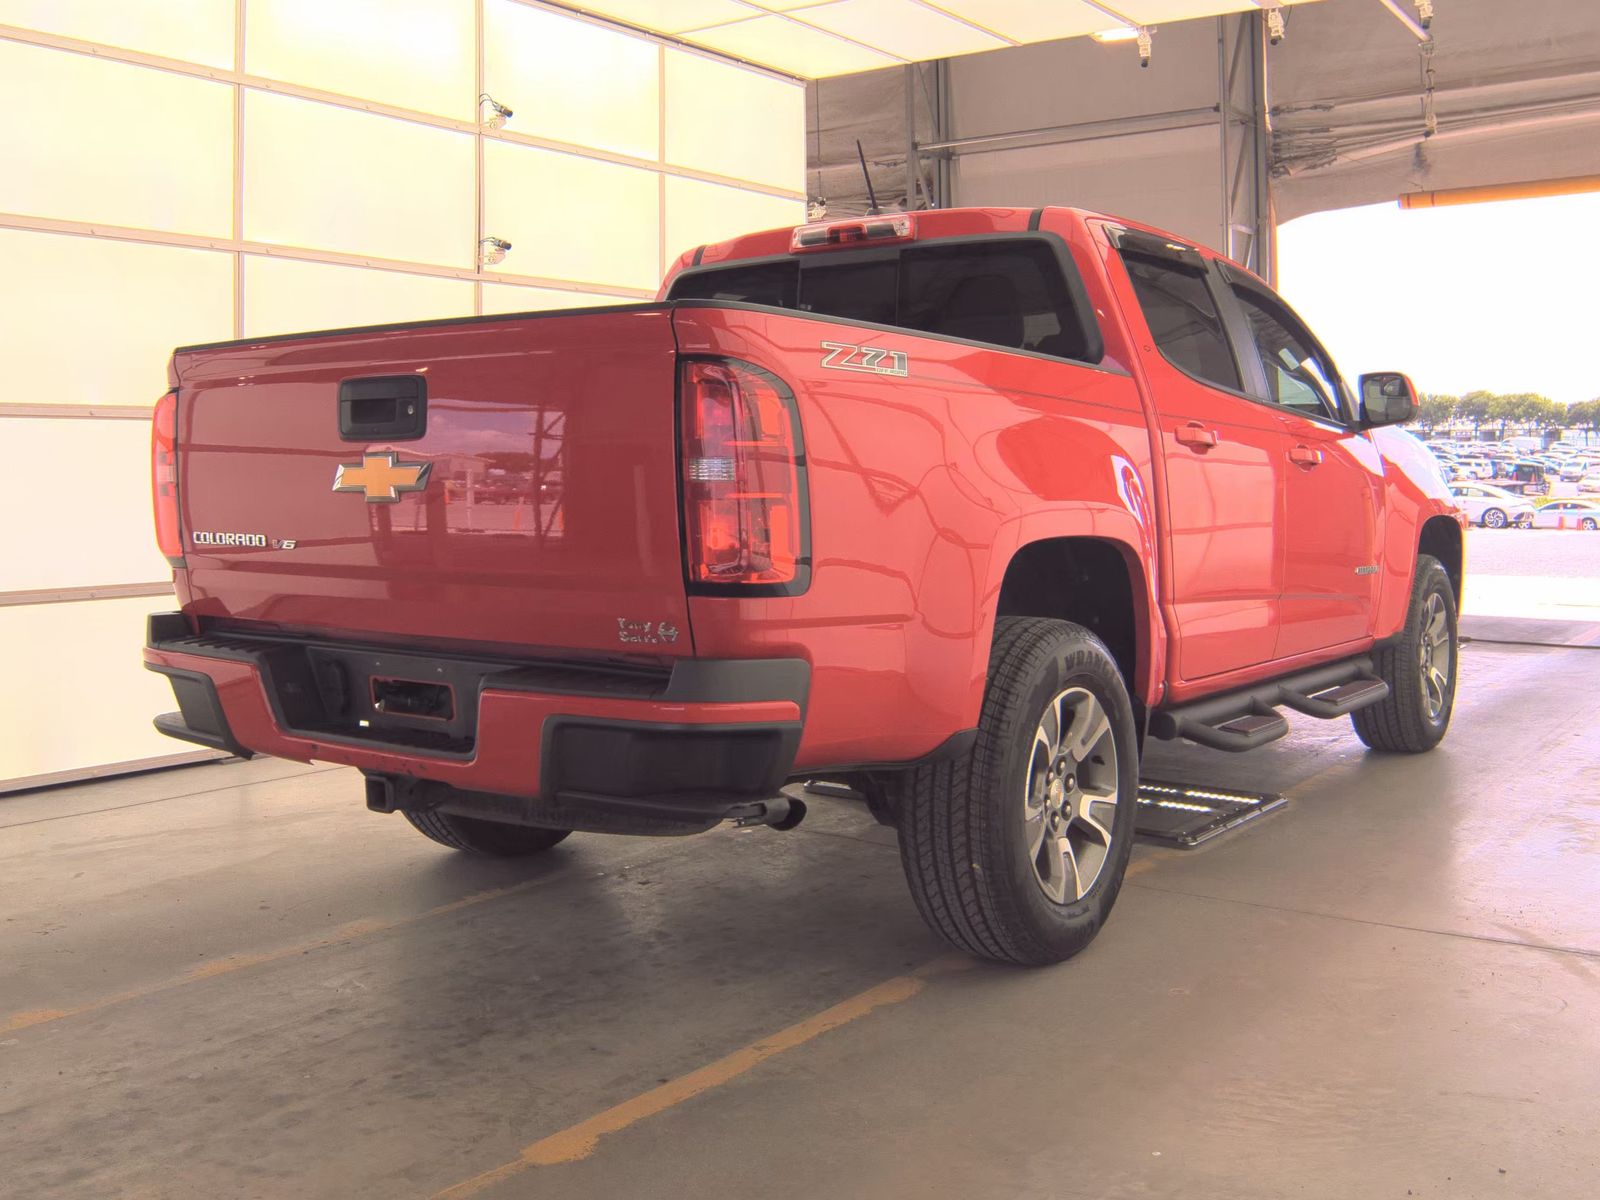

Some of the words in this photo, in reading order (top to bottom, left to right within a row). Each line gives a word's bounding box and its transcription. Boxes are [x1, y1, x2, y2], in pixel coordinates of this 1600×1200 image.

[820, 340, 908, 377] Z71
[193, 531, 266, 547] COLORADO
[272, 539, 297, 549] V6
